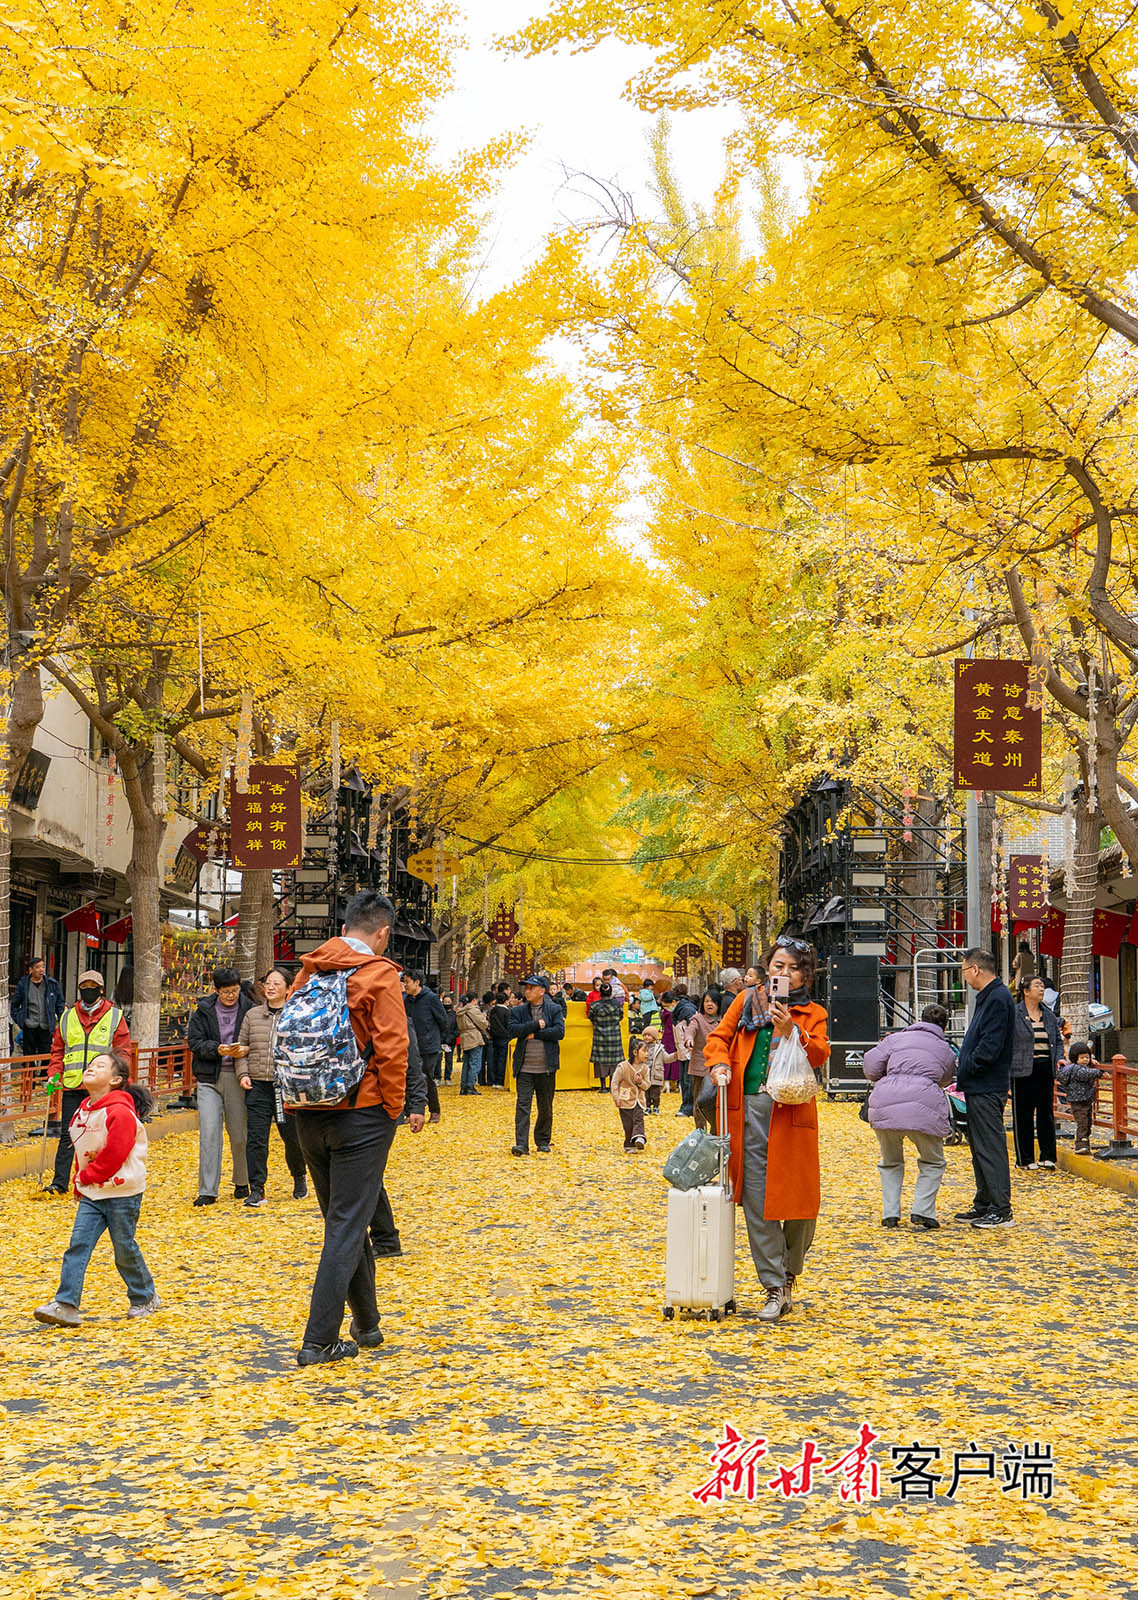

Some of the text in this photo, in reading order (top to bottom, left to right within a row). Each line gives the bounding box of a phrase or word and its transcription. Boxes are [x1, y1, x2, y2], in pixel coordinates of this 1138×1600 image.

[972, 683, 994, 767] 黄金大道
[1002, 683, 1024, 768] 诗意秦州
